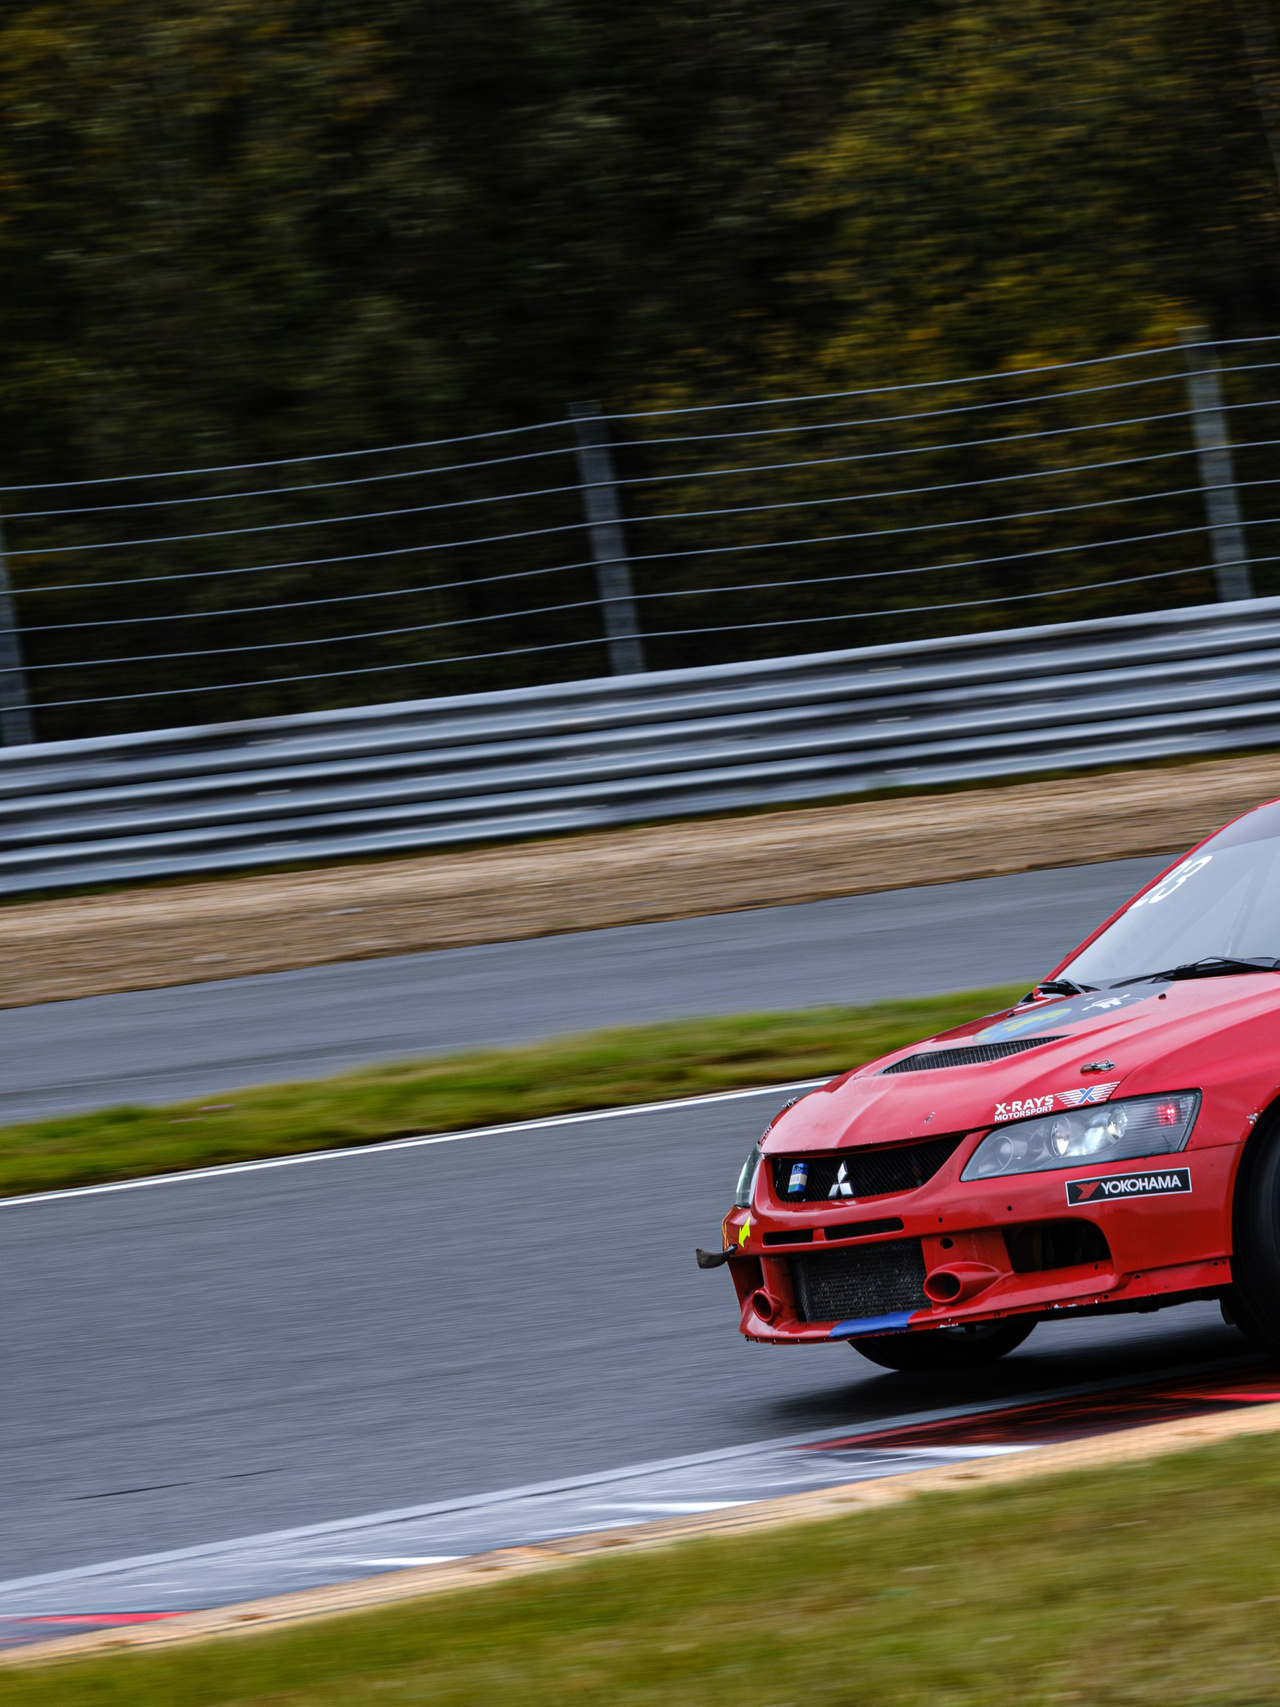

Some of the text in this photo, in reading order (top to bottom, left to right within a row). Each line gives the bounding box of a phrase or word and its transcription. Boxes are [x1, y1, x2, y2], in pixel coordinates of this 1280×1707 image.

[994, 1094, 1054, 1115] X-RAYS
[994, 1105, 1054, 1122] MOTORSPORT
[1101, 1175, 1182, 1195] YOKOHAMA
